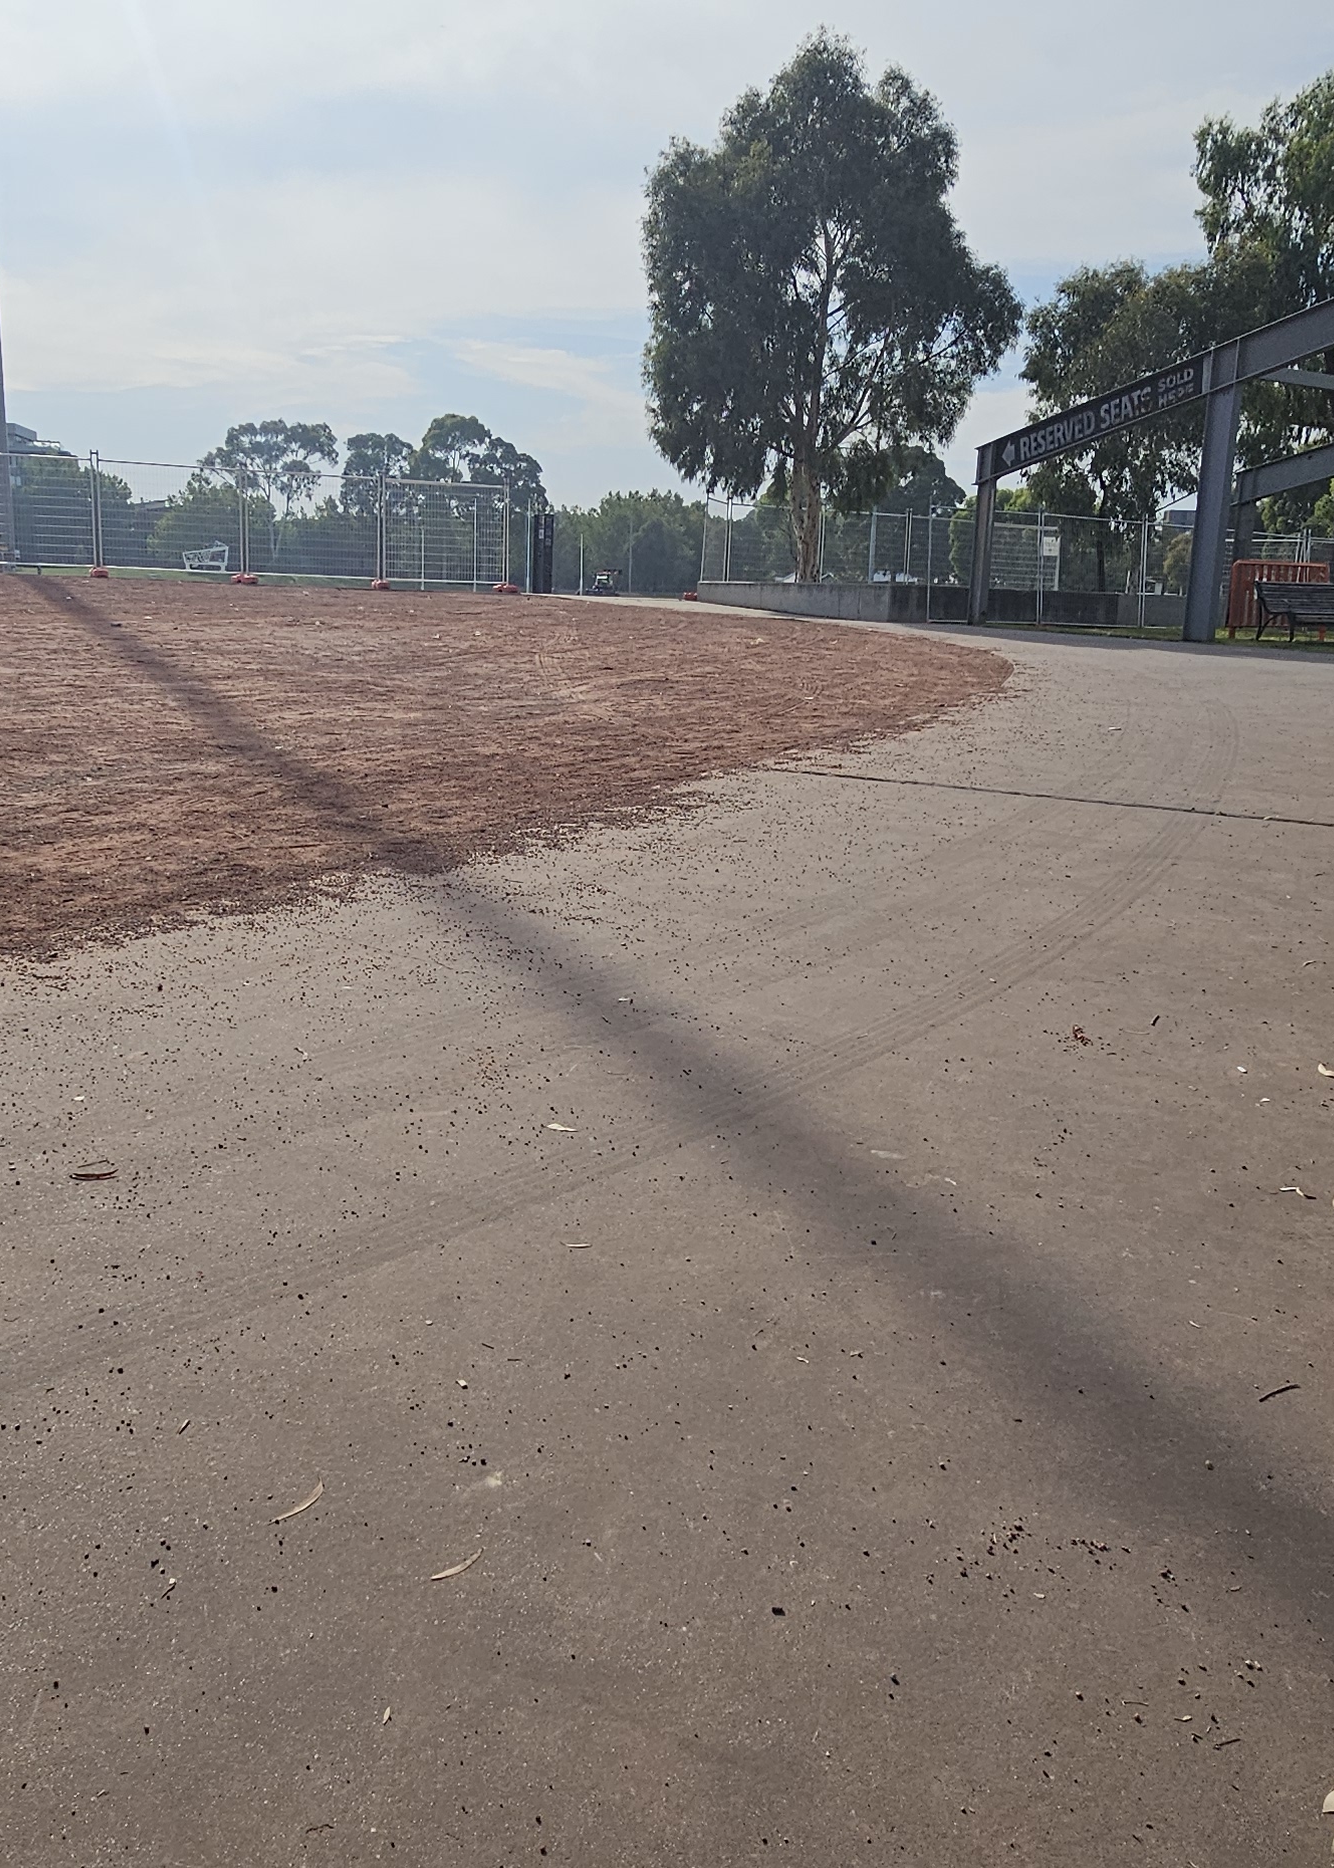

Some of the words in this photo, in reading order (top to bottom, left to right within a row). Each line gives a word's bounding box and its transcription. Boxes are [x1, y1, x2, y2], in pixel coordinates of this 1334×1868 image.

[1157, 367, 1194, 392] SOLD
[1020, 411, 1095, 461] RESERVED
[1100, 386, 1152, 429] SEATS
